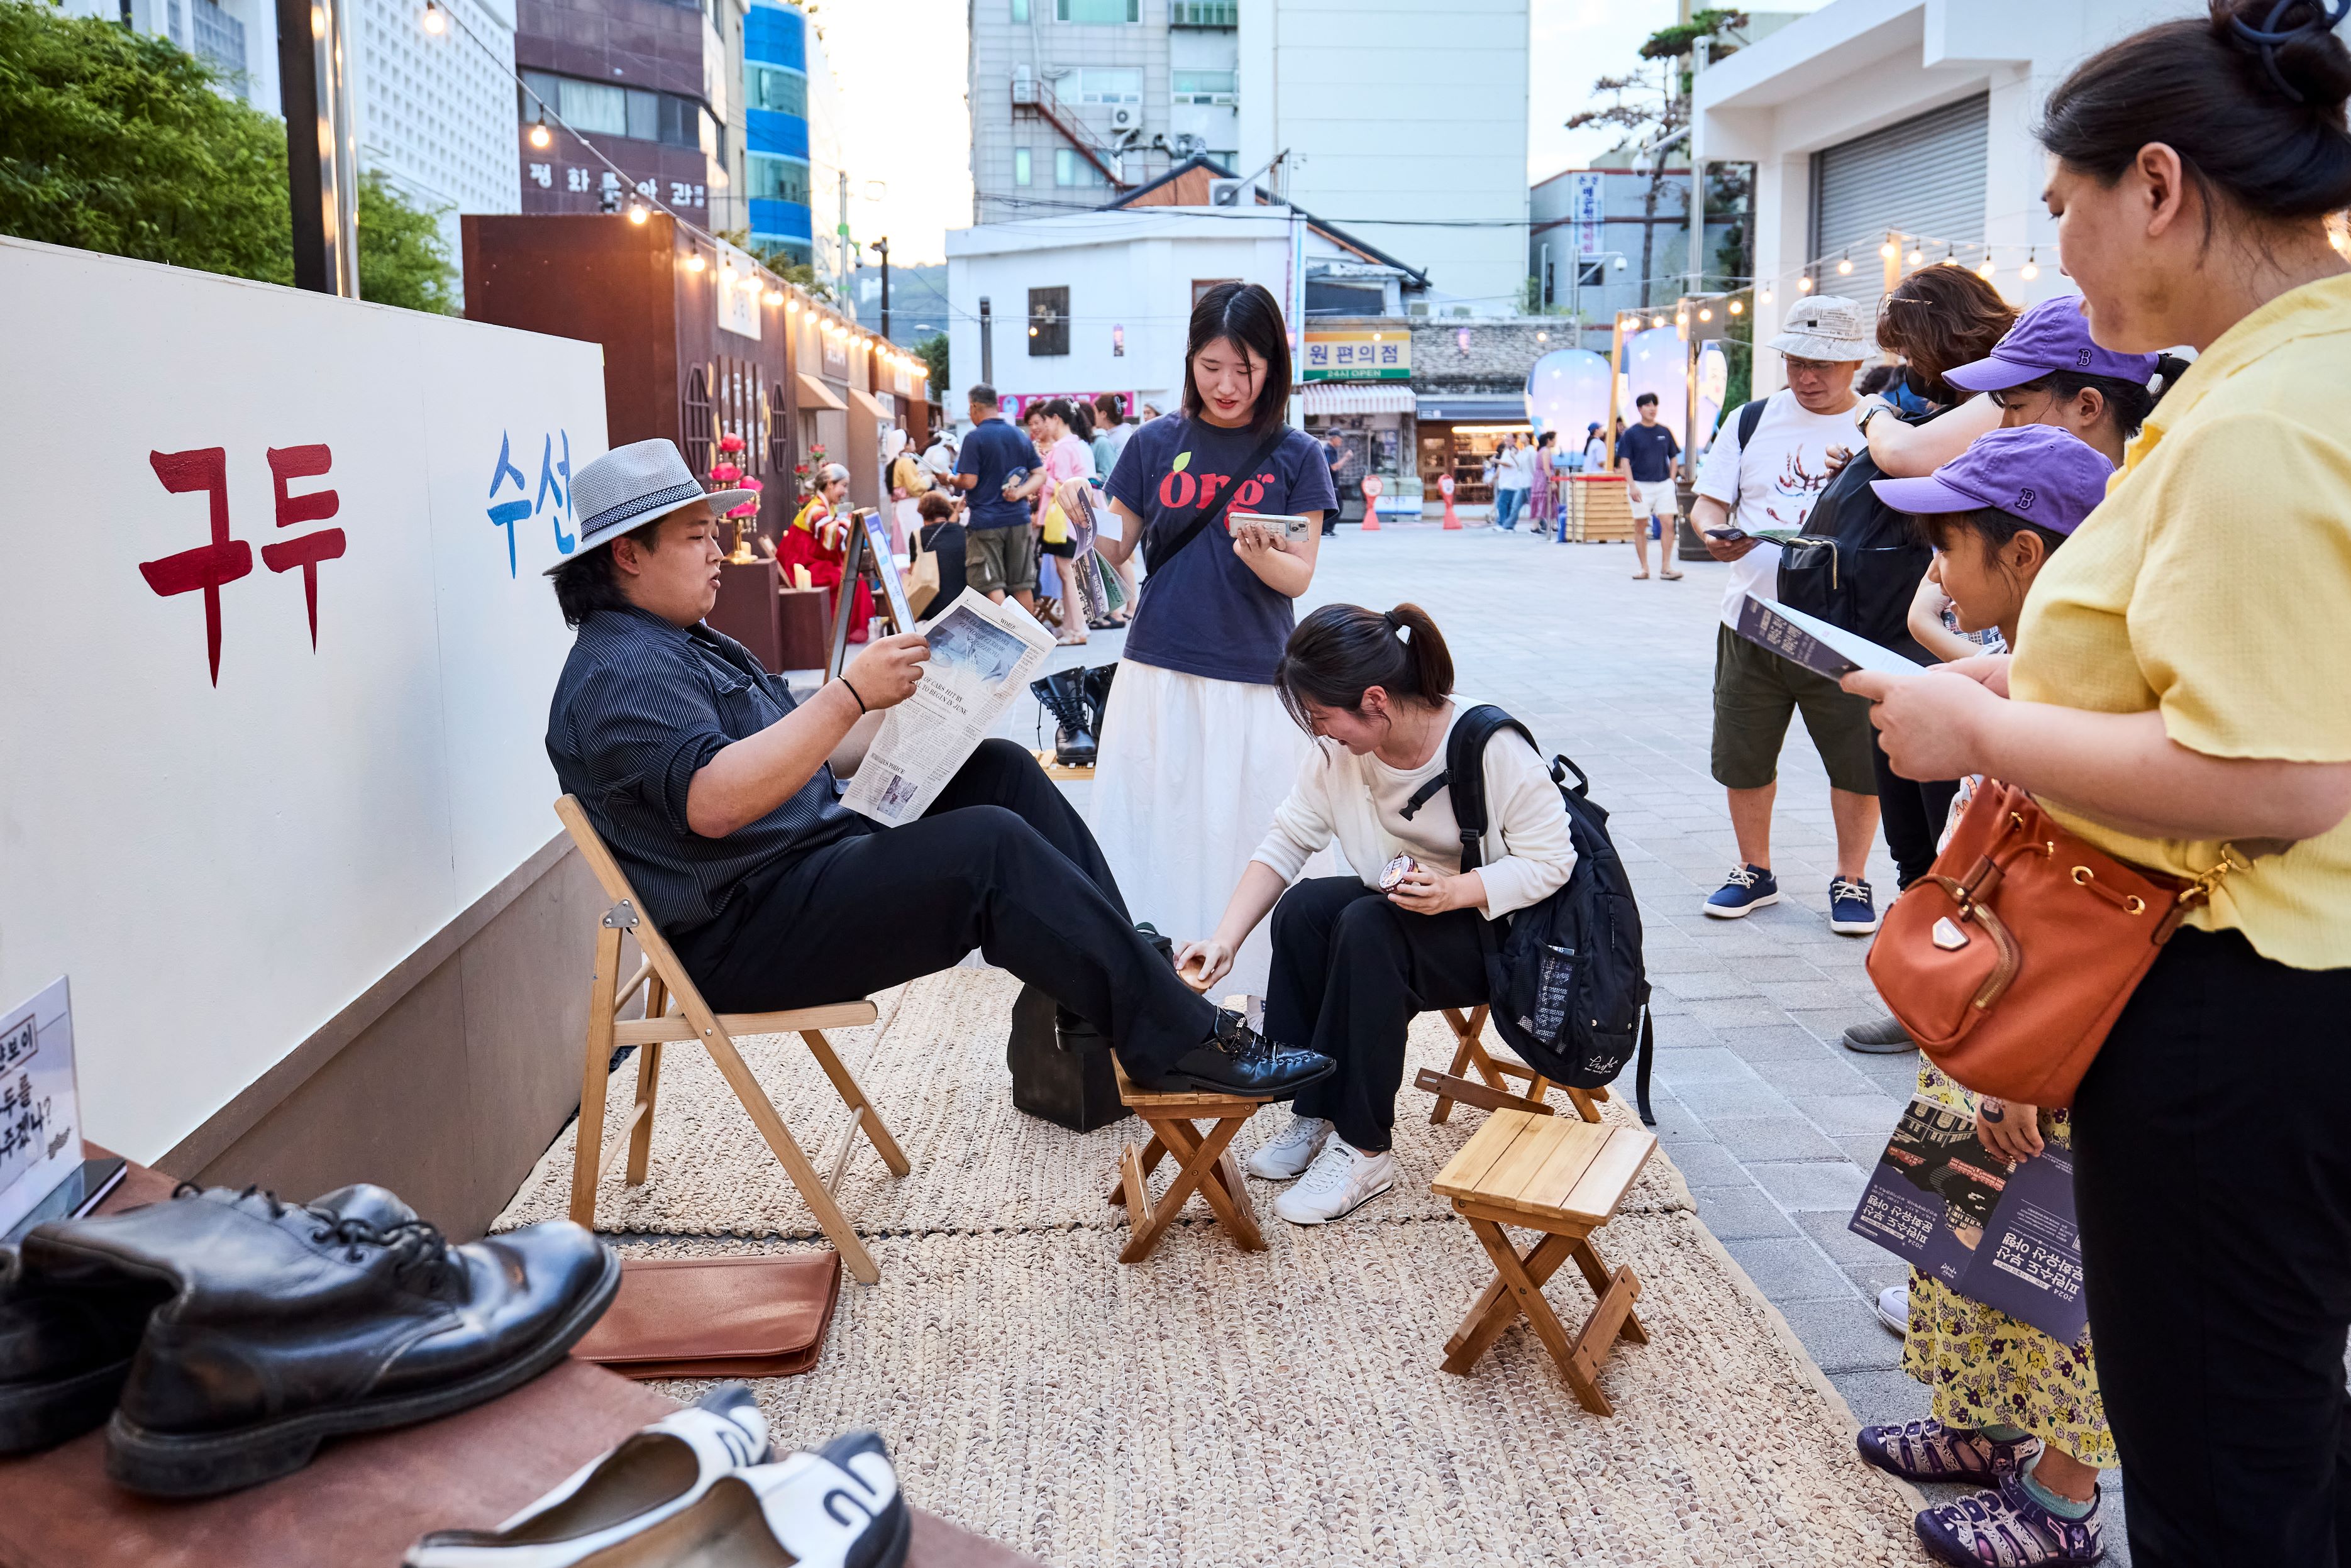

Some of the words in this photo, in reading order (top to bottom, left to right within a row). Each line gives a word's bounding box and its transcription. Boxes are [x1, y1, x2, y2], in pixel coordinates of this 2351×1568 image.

[1310, 345, 1328, 365] 원
[1337, 345, 1397, 363] 편의점
[2077, 349, 2092, 367] B
[487, 428, 574, 580] 수선
[2015, 487, 2036, 510] B
[139, 443, 346, 689] 구두
[999, 617, 1016, 630] WORLD
[921, 684, 930, 692] TO
[929, 688, 947, 703] BEGIN
[952, 703, 968, 715] JUNE
[922, 676, 933, 685] OF
[931, 680, 946, 692] CARS
[944, 688, 956, 698] HIT
[954, 695, 963, 703] BY
[888, 762, 905, 775] POLICE
[1861, 1203, 1886, 1222] 부산
[1866, 1193, 1890, 1212] 야행
[1884, 1214, 1929, 1244] 피란수도
[1889, 1203, 1934, 1234] 문화유산
[1907, 1238, 1923, 1249] 2024
[2001, 1231, 2032, 1255] 야행
[1994, 1244, 2025, 1268] 부산
[2030, 1244, 2087, 1283] 문화유산
[2024, 1257, 2081, 1296] 피란수도
[2052, 1288, 2074, 1302] 2024
